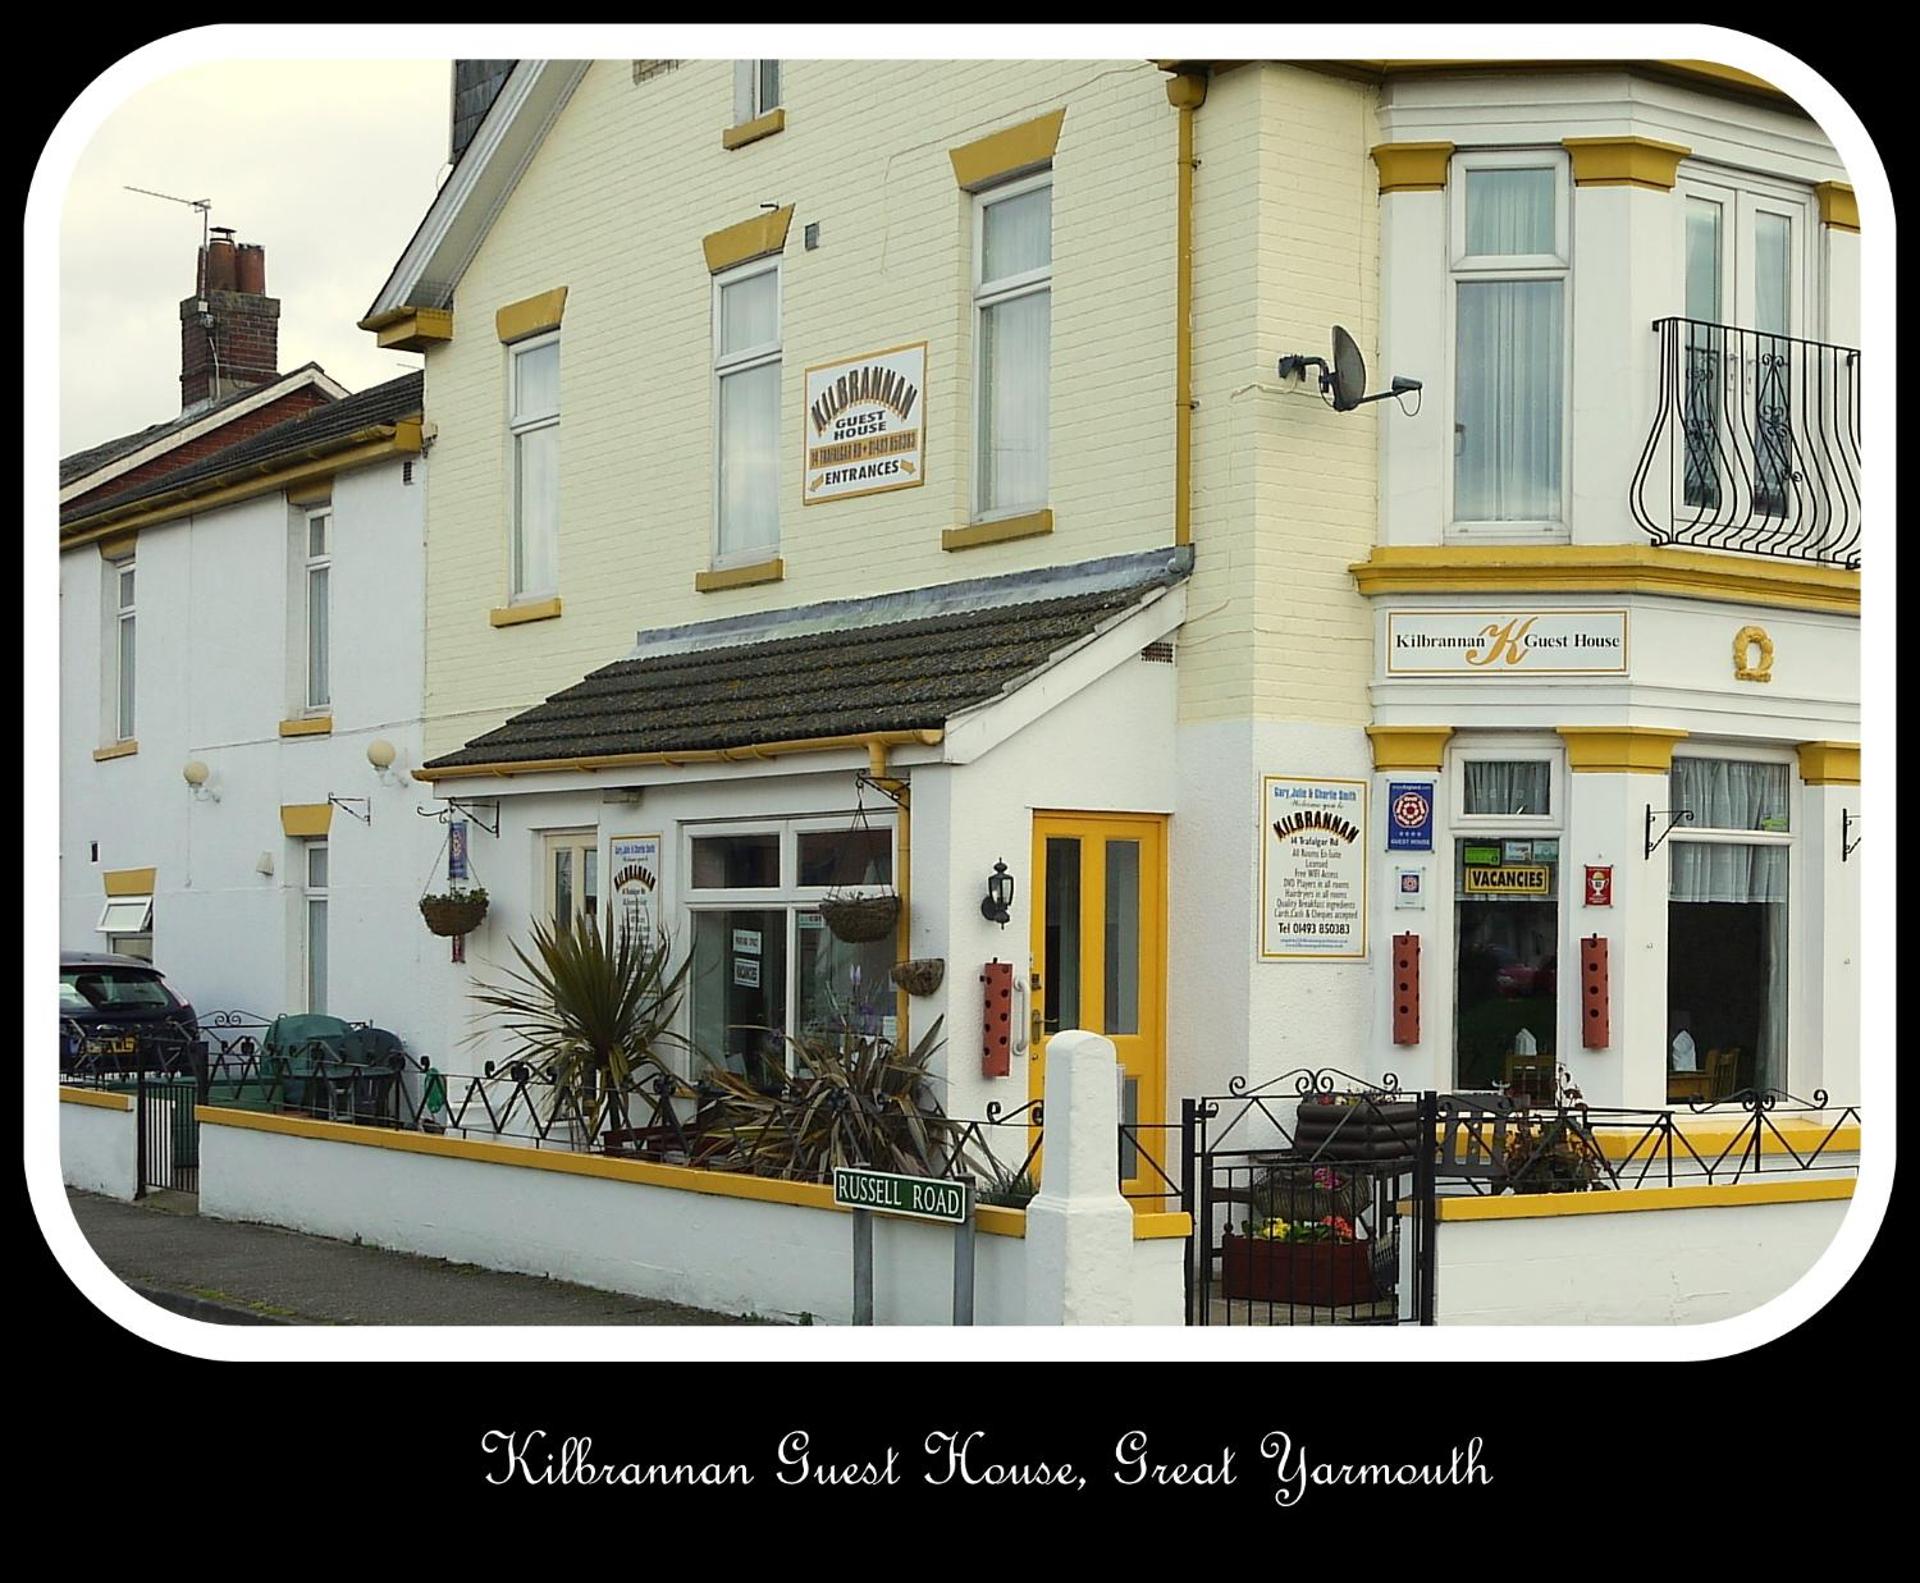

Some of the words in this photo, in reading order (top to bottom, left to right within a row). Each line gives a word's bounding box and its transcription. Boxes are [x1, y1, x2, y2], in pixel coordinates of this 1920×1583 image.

[811, 366, 918, 437] KILBRANNAN
[835, 410, 886, 429] GUEST
[834, 421, 887, 440] HOUSE
[825, 460, 899, 485] ENTRANCES
[1396, 633, 1485, 648] Kilbrannan
[1466, 616, 1538, 666] K
[1524, 633, 1568, 648] Guest
[1573, 633, 1620, 648] House
[1273, 811, 1360, 844] KILBRANNAN
[1299, 836, 1328, 847] Trafalgar
[1329, 837, 1339, 846] Rd
[1295, 868, 1306, 878] Free
[1321, 869, 1338, 879] Access
[1472, 870, 1543, 888] VACANCIES
[1296, 879, 1316, 889] Players
[1276, 897, 1298, 908] Quality
[1306, 909, 1311, 918] &
[1278, 923, 1290, 934] Tel
[1293, 923, 1316, 934] 01493
[1319, 923, 1350, 934] 850383
[839, 1174, 902, 1206] RUSSELL
[913, 1184, 960, 1215] ROAD
